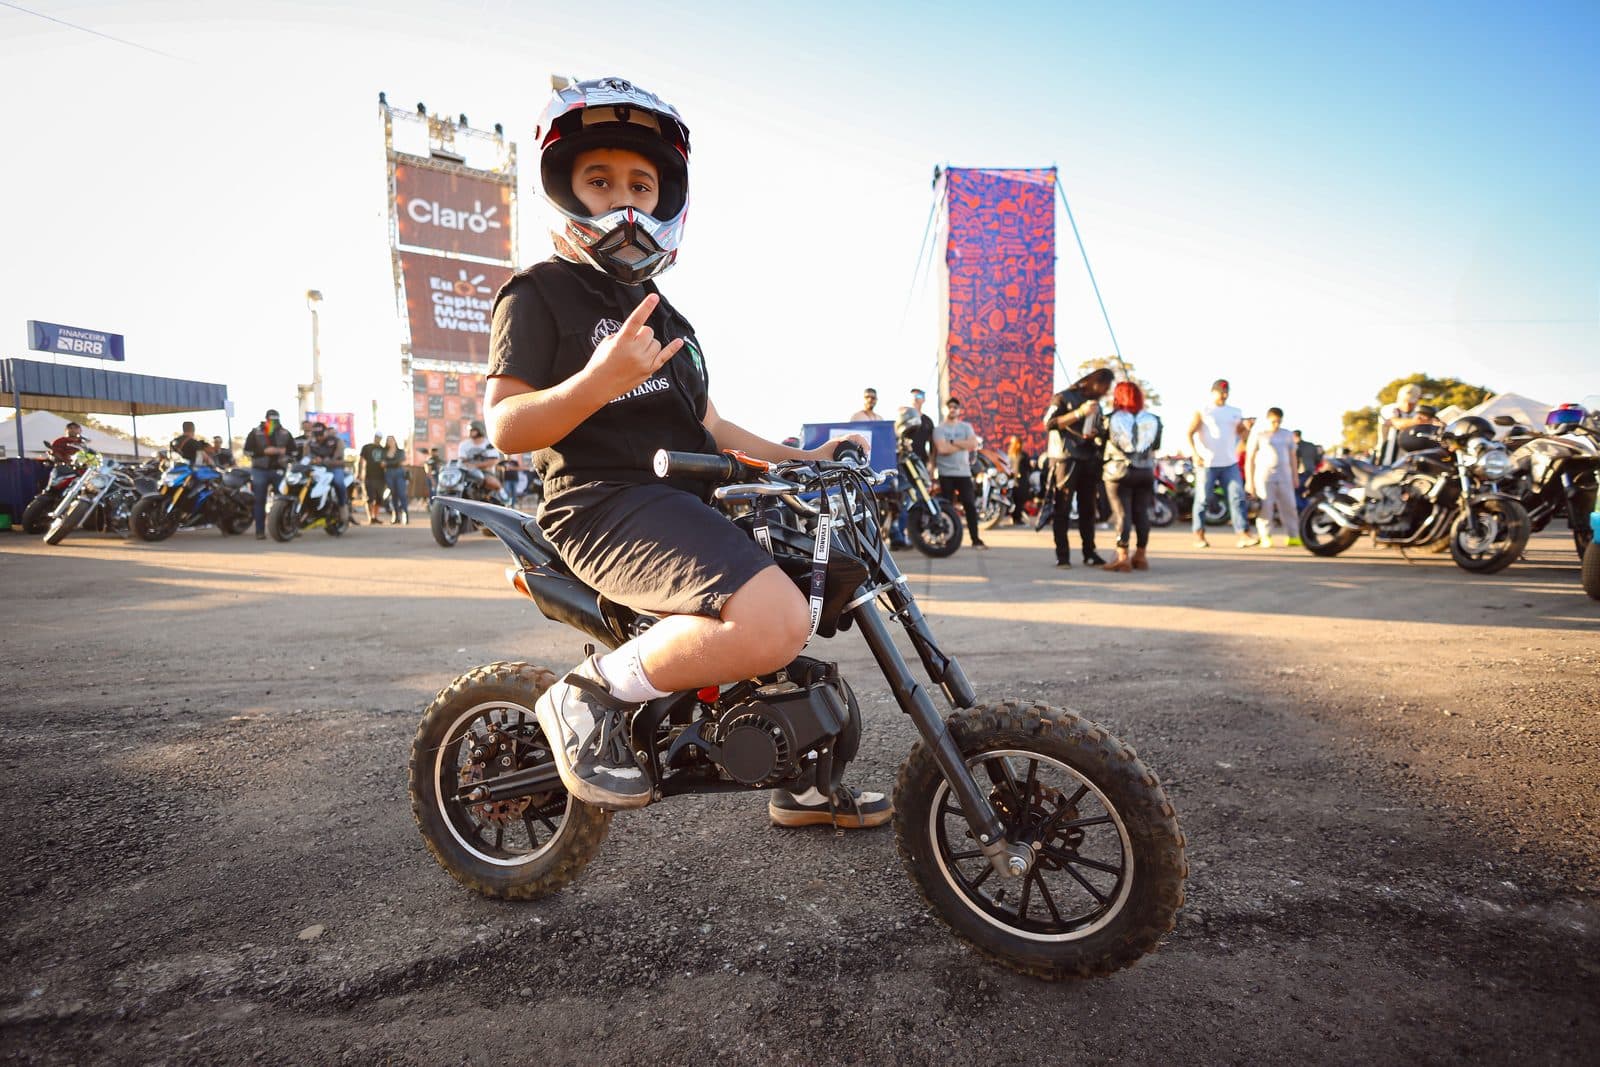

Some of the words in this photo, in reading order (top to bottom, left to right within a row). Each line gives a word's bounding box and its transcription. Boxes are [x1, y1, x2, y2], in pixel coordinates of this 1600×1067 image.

[407, 198, 488, 233] Claro
[429, 276, 453, 292] Eu
[434, 304, 486, 320] Moto
[435, 316, 491, 333] Week
[59, 327, 106, 342] FINANCEIRA
[73, 339, 103, 355] BRB
[609, 377, 670, 404] VIANOS
